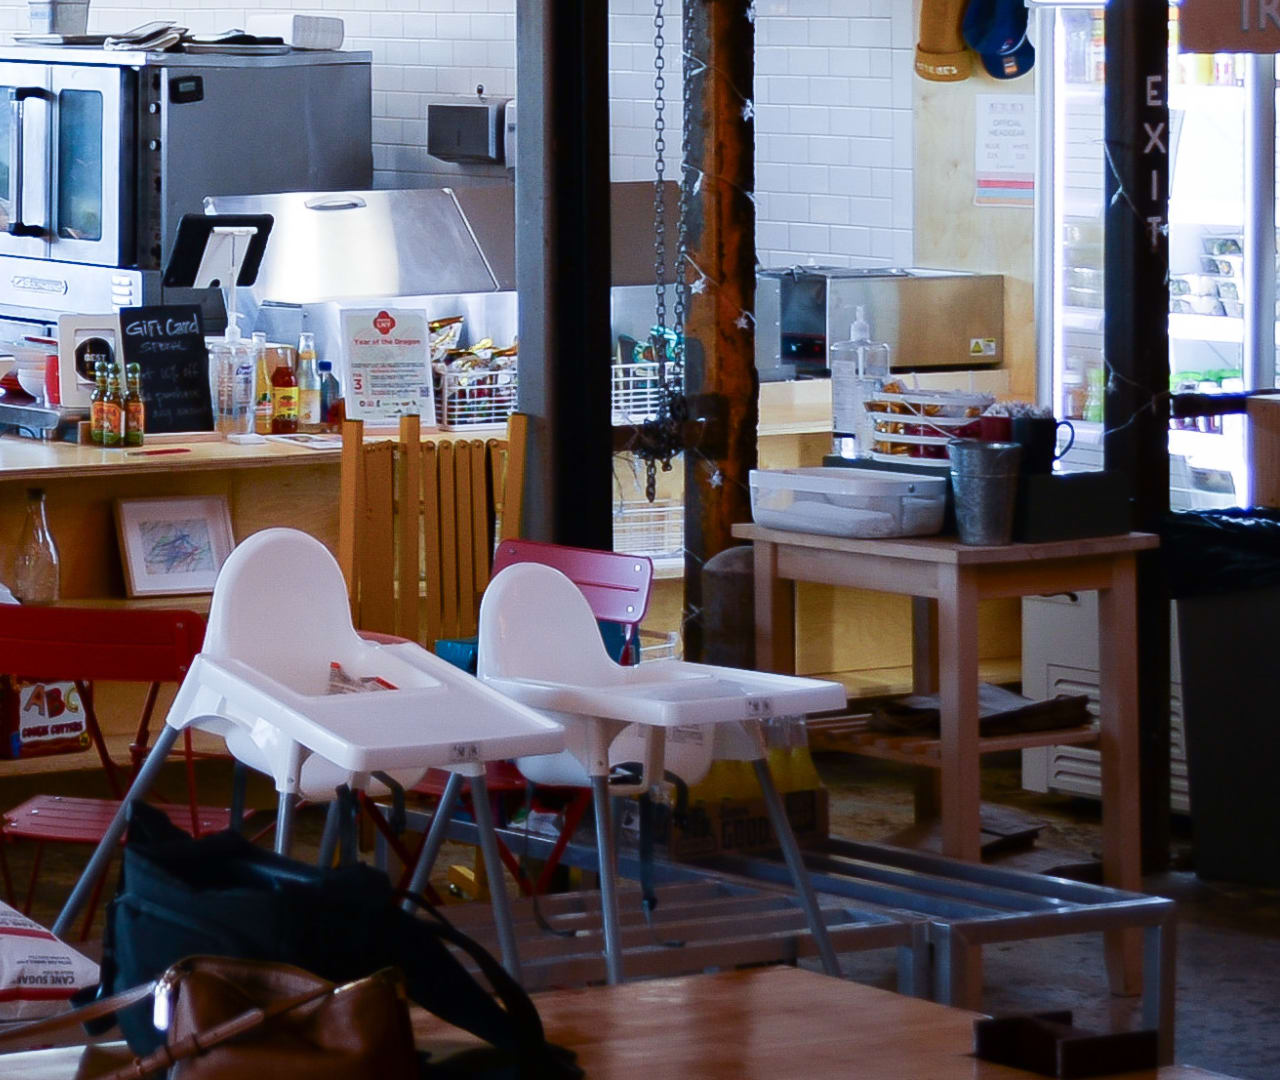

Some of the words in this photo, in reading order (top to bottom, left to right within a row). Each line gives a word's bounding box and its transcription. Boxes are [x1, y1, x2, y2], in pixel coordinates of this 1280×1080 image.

[1143, 75, 1167, 252] EXIT
[24, 683, 78, 718] ABC
[49, 975, 75, 985] CANE
